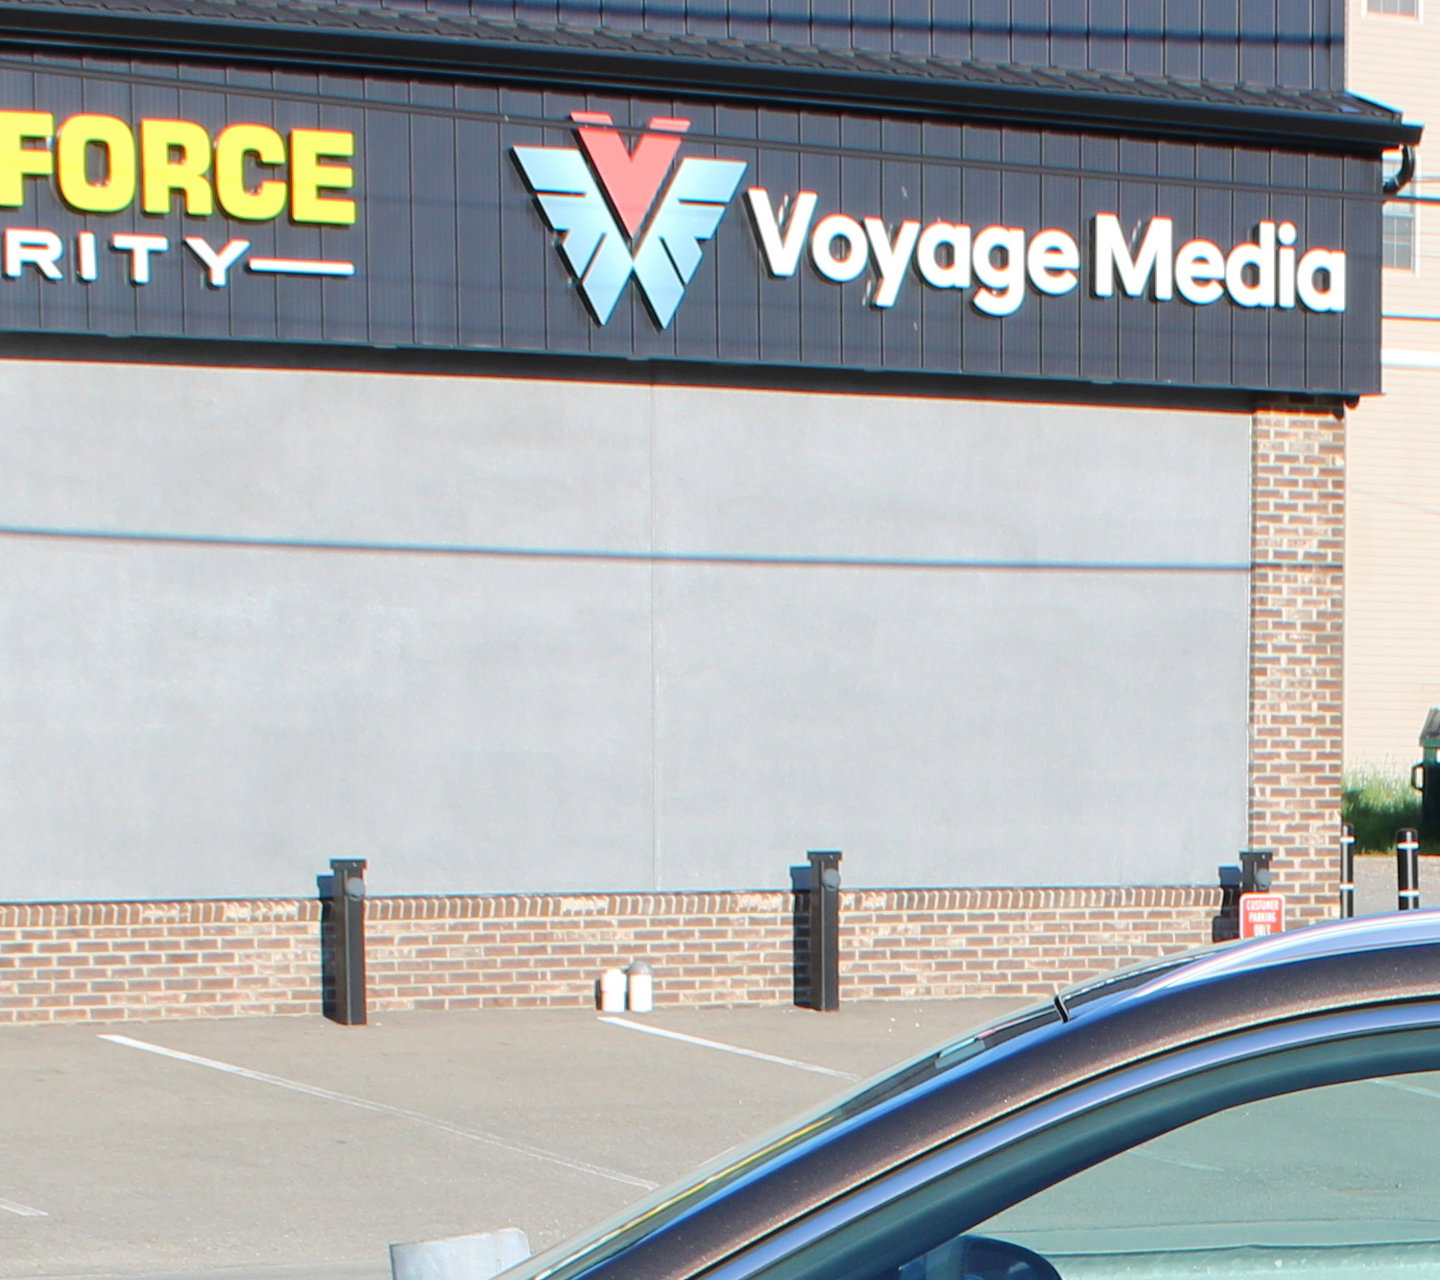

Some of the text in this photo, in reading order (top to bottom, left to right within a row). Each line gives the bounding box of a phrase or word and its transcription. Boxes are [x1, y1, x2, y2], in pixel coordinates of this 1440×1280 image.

[747, 187, 1347, 316] Voyage Media
[1246, 899, 1279, 910] CUSTOMER
[1248, 912, 1277, 923] PARKING
